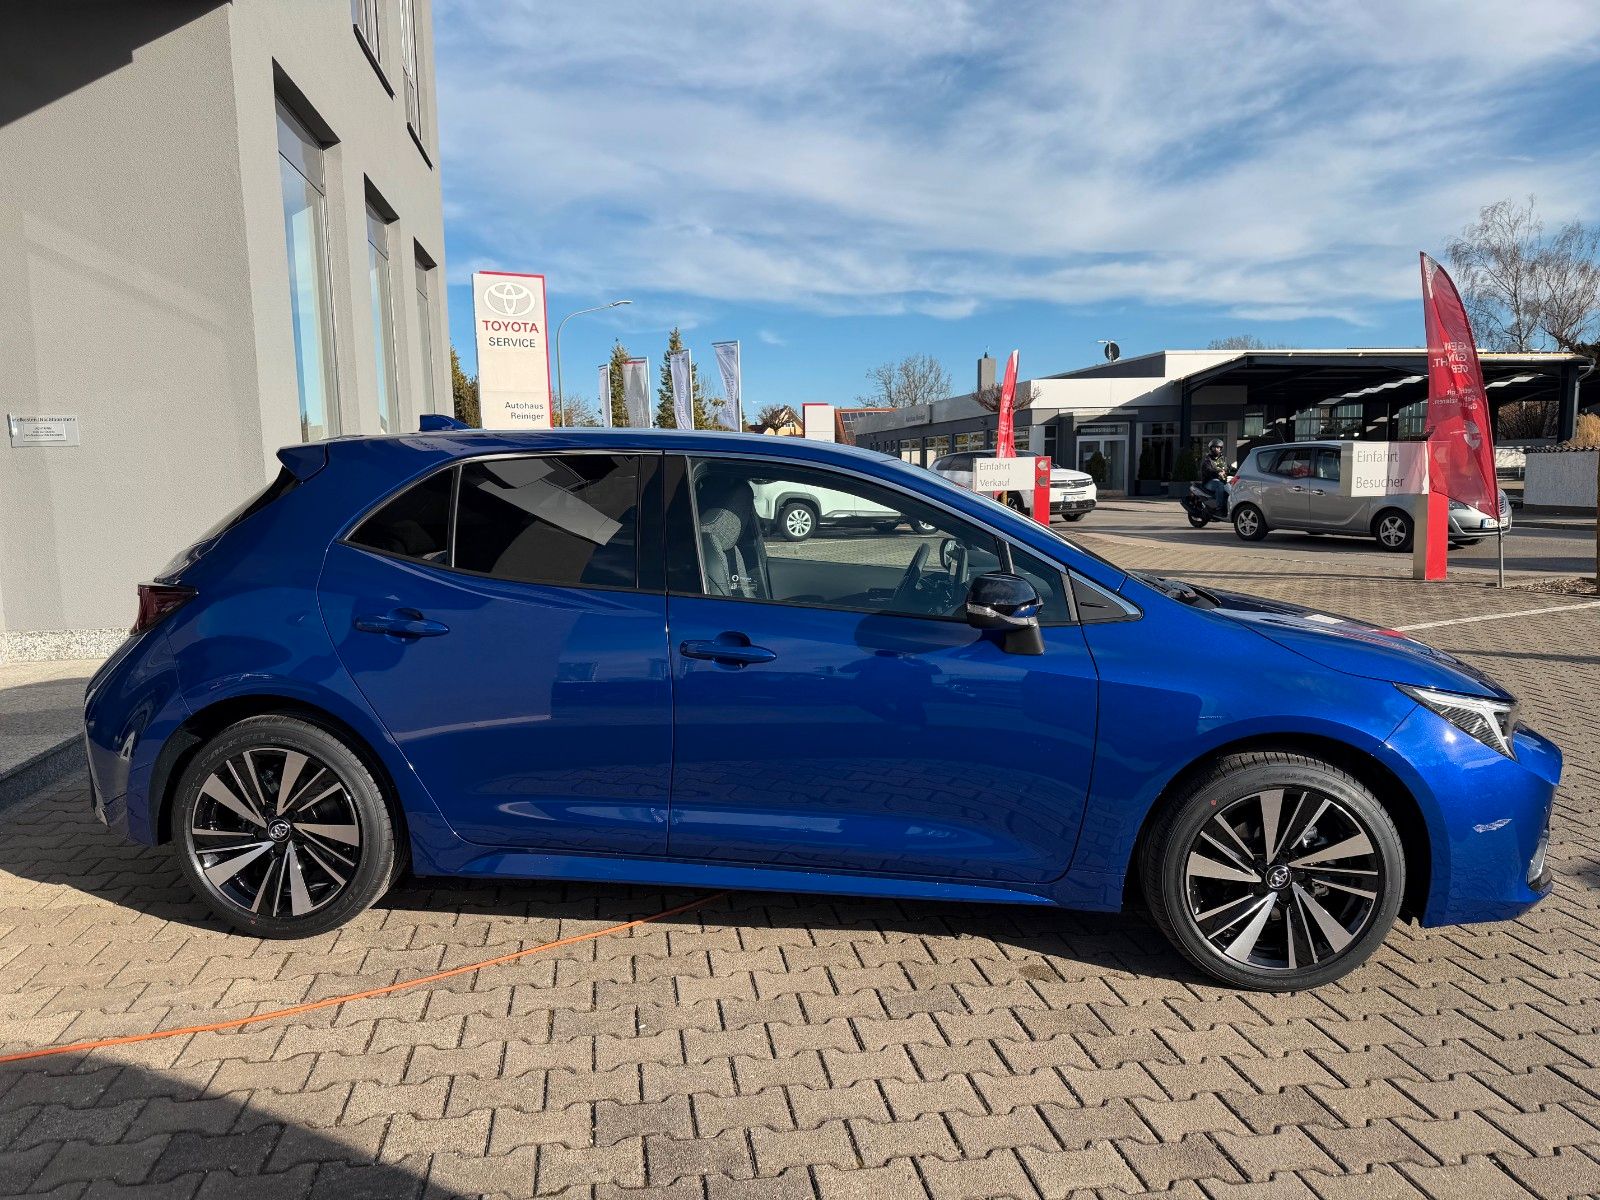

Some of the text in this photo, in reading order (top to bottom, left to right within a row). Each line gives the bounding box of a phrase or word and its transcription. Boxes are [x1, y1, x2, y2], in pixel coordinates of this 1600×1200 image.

[482, 319, 540, 334] TOYOTA
[488, 336, 536, 348] SERVICE
[504, 401, 544, 410] Autohaus
[510, 412, 544, 422] Reiniger
[1357, 450, 1400, 463] Einfahrt
[979, 462, 1010, 471] Einfahrt
[980, 478, 1010, 487] Verkauf
[1355, 476, 1405, 489] Besucher
